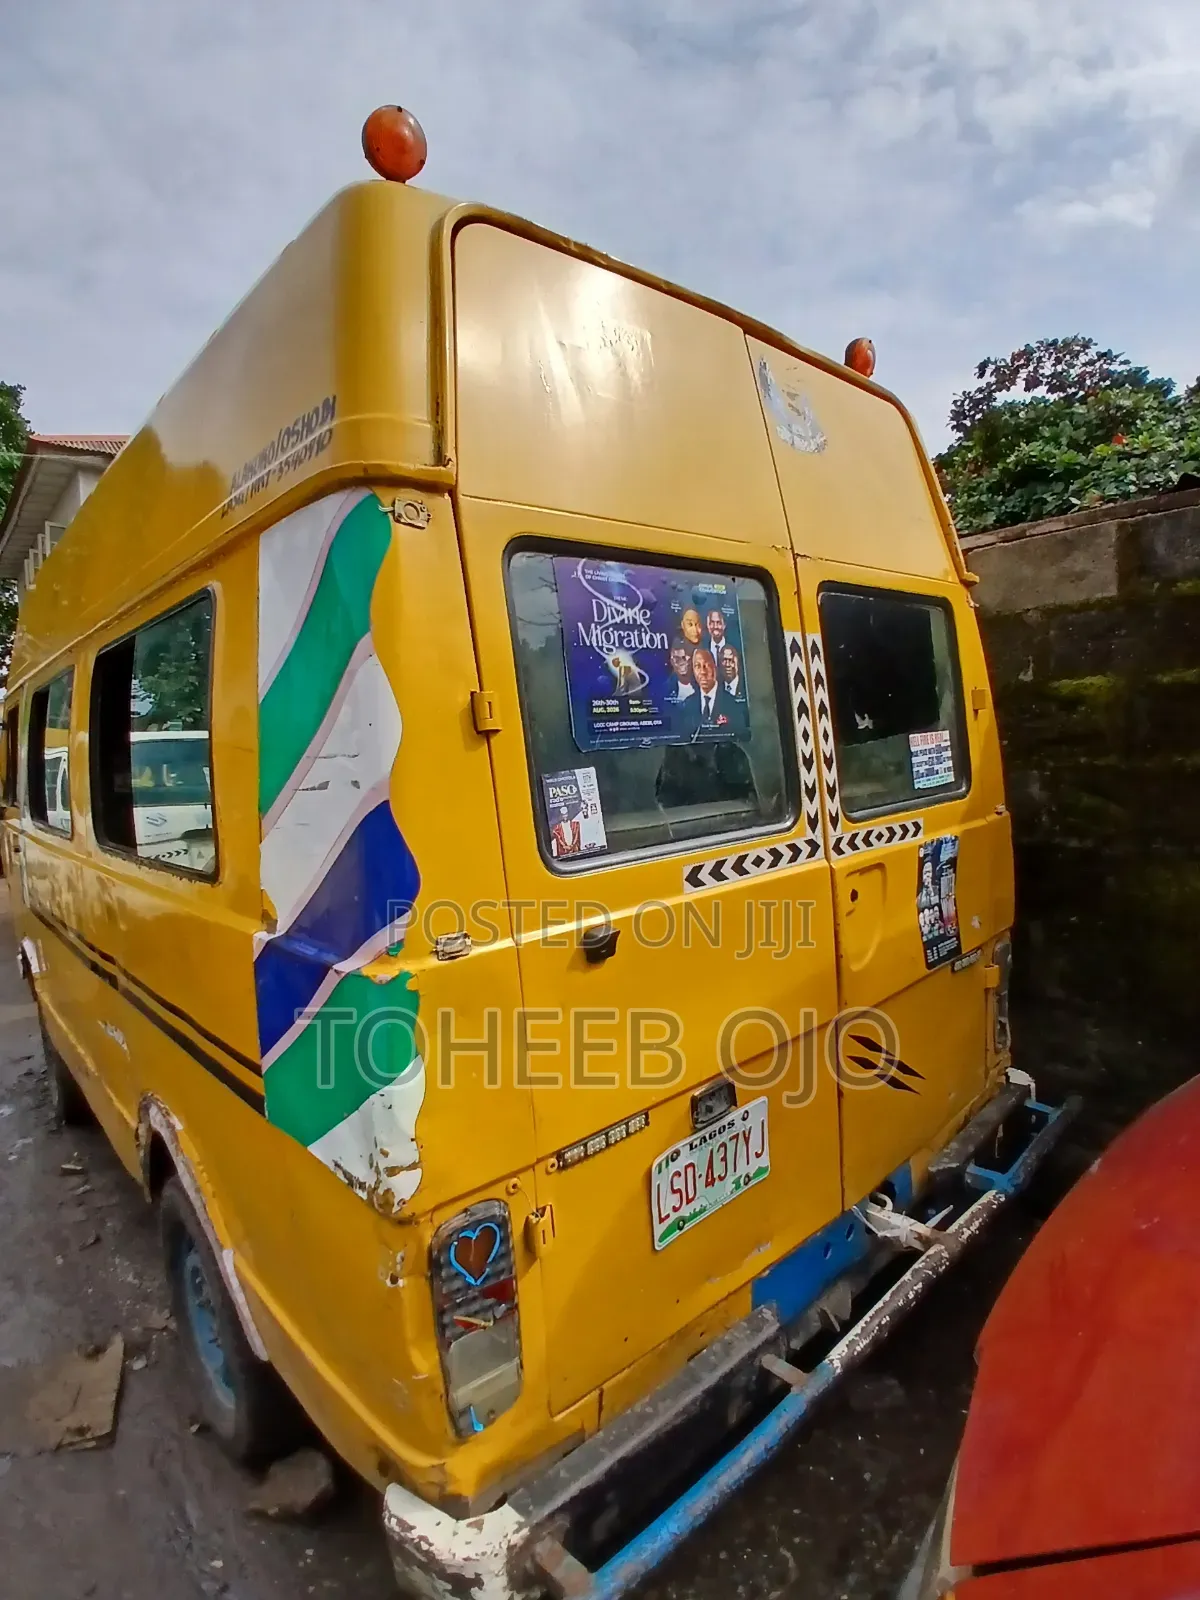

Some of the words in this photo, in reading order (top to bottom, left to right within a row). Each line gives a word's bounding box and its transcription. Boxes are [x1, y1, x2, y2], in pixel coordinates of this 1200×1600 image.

[592, 599, 652, 626] Divine
[577, 622, 669, 654] Migration
[688, 1118, 736, 1152] LAGOS
